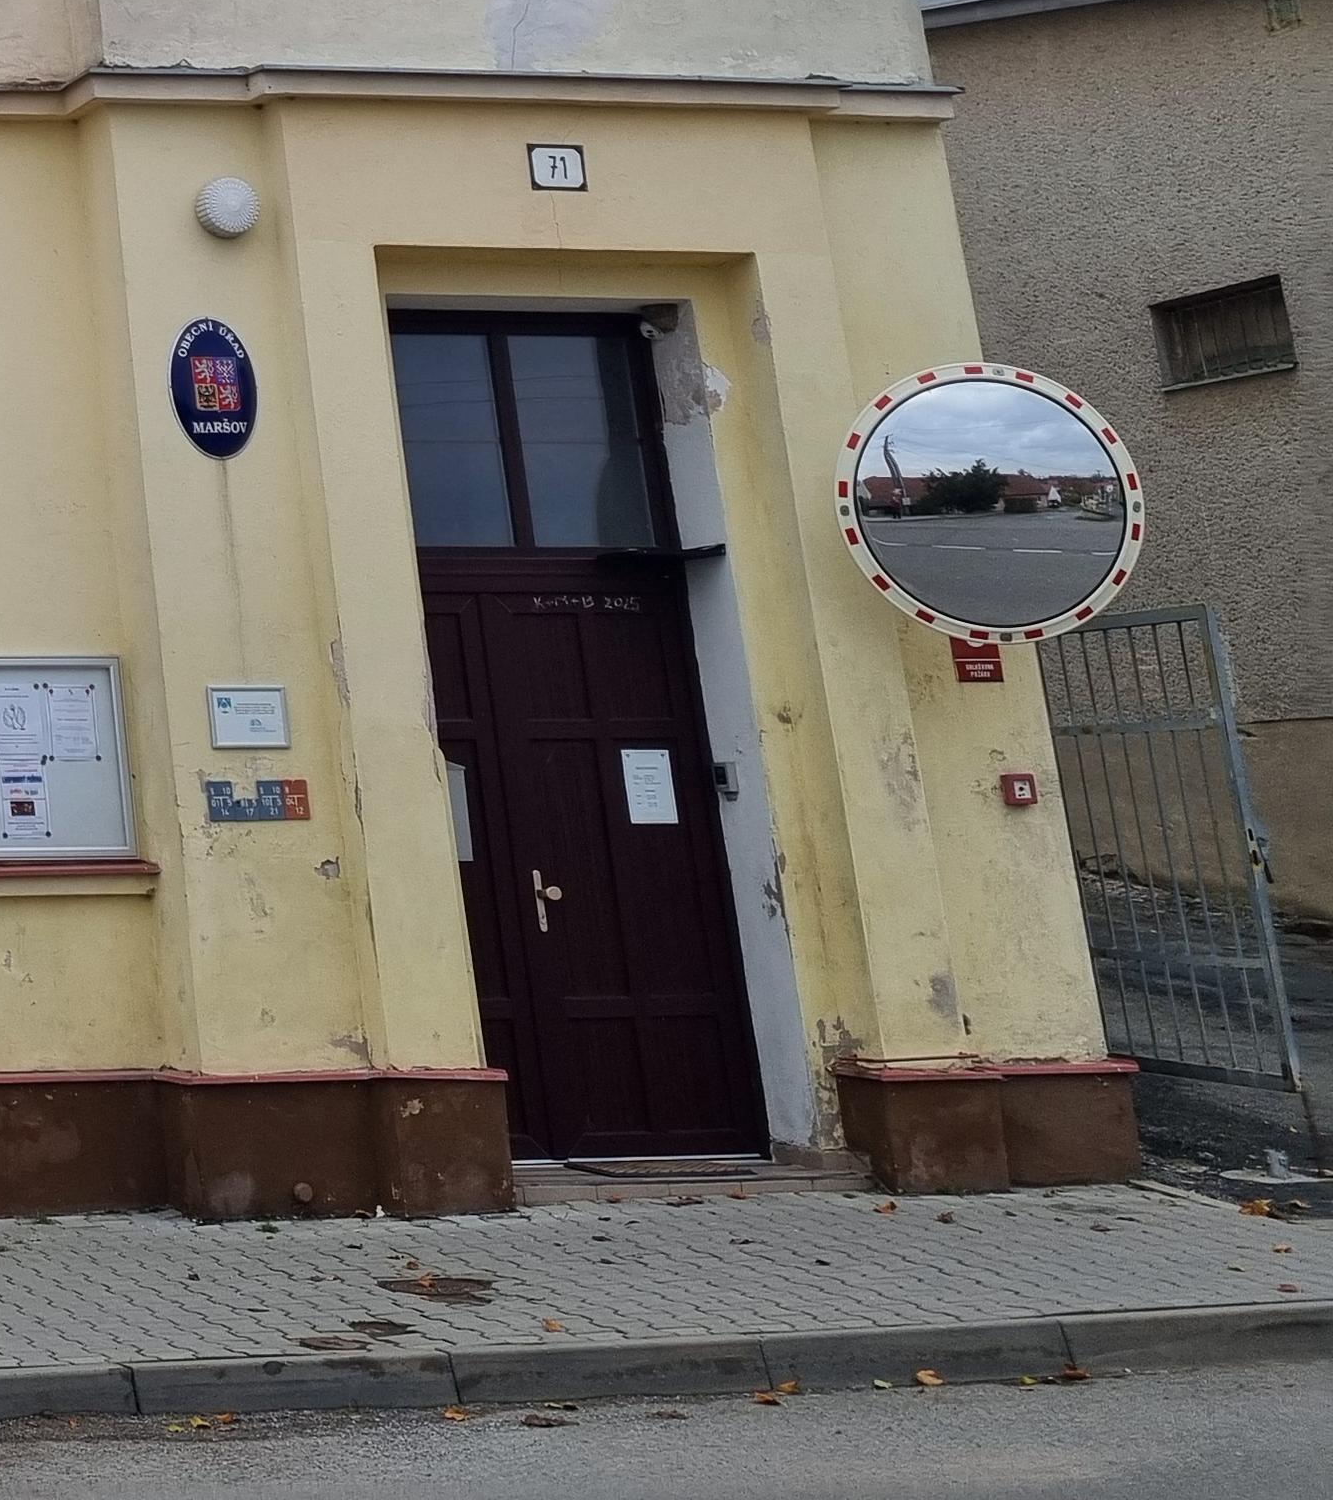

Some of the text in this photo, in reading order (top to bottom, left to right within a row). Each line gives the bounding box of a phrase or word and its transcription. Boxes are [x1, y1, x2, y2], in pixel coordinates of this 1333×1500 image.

[547, 155, 568, 180] 71
[178, 321, 245, 358] OBECNÍ ÚŘAD
[193, 419, 248, 434] MARŠOV
